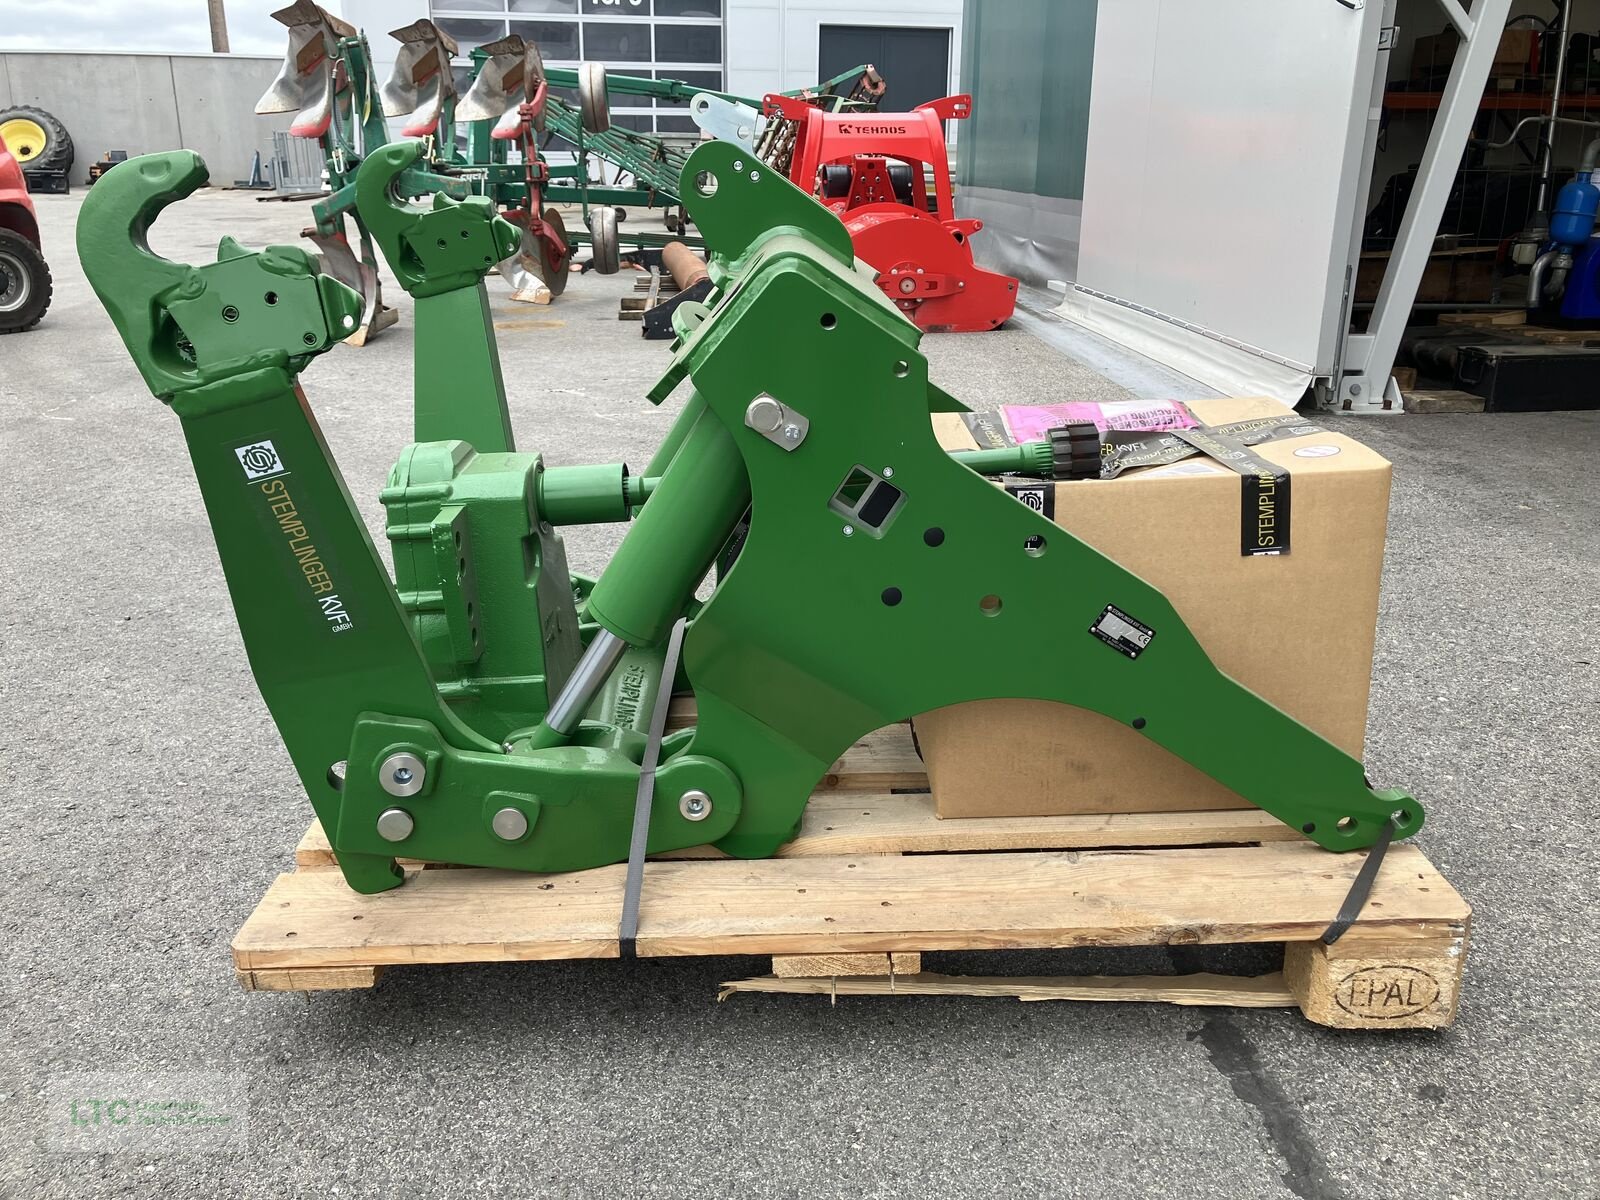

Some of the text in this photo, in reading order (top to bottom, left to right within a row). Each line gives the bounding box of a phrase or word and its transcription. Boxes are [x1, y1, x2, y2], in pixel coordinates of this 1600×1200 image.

[855, 126, 906, 134] TEHNOS
[261, 479, 350, 624] STEMPLINGER KVF
[331, 622, 354, 633] GMBH
[1349, 978, 1421, 1007] EPAL
